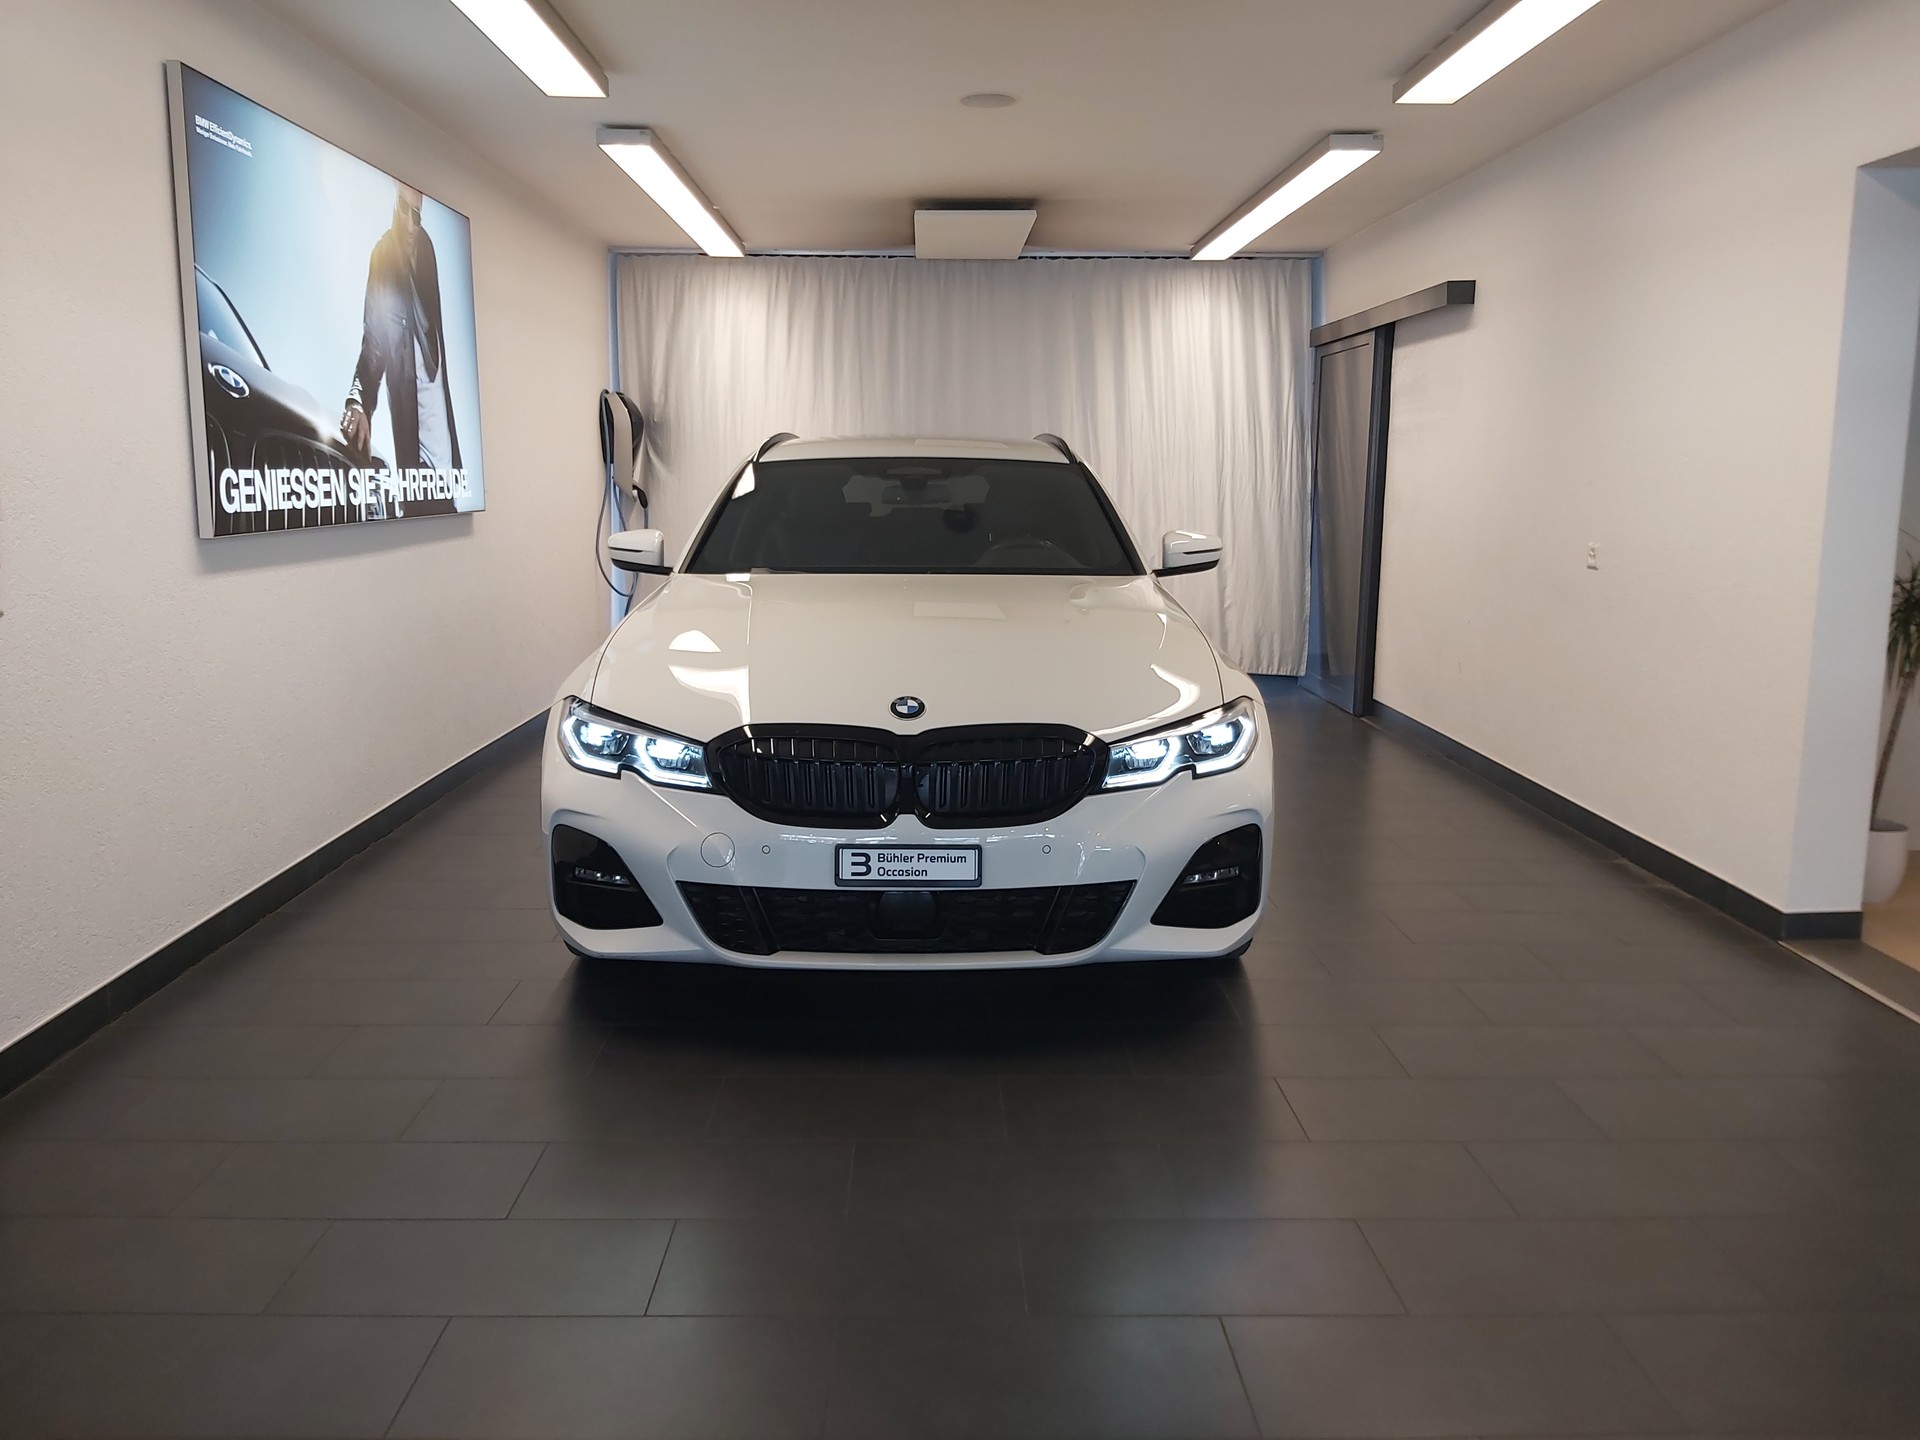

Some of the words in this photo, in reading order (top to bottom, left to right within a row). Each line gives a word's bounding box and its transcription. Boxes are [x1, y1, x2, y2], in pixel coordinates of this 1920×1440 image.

[220, 468, 345, 513] GENIESSEN
[348, 468, 377, 506] SIE
[877, 853, 915, 864] Bühler
[917, 853, 967, 864] Premium
[877, 866, 928, 877] Occasion
